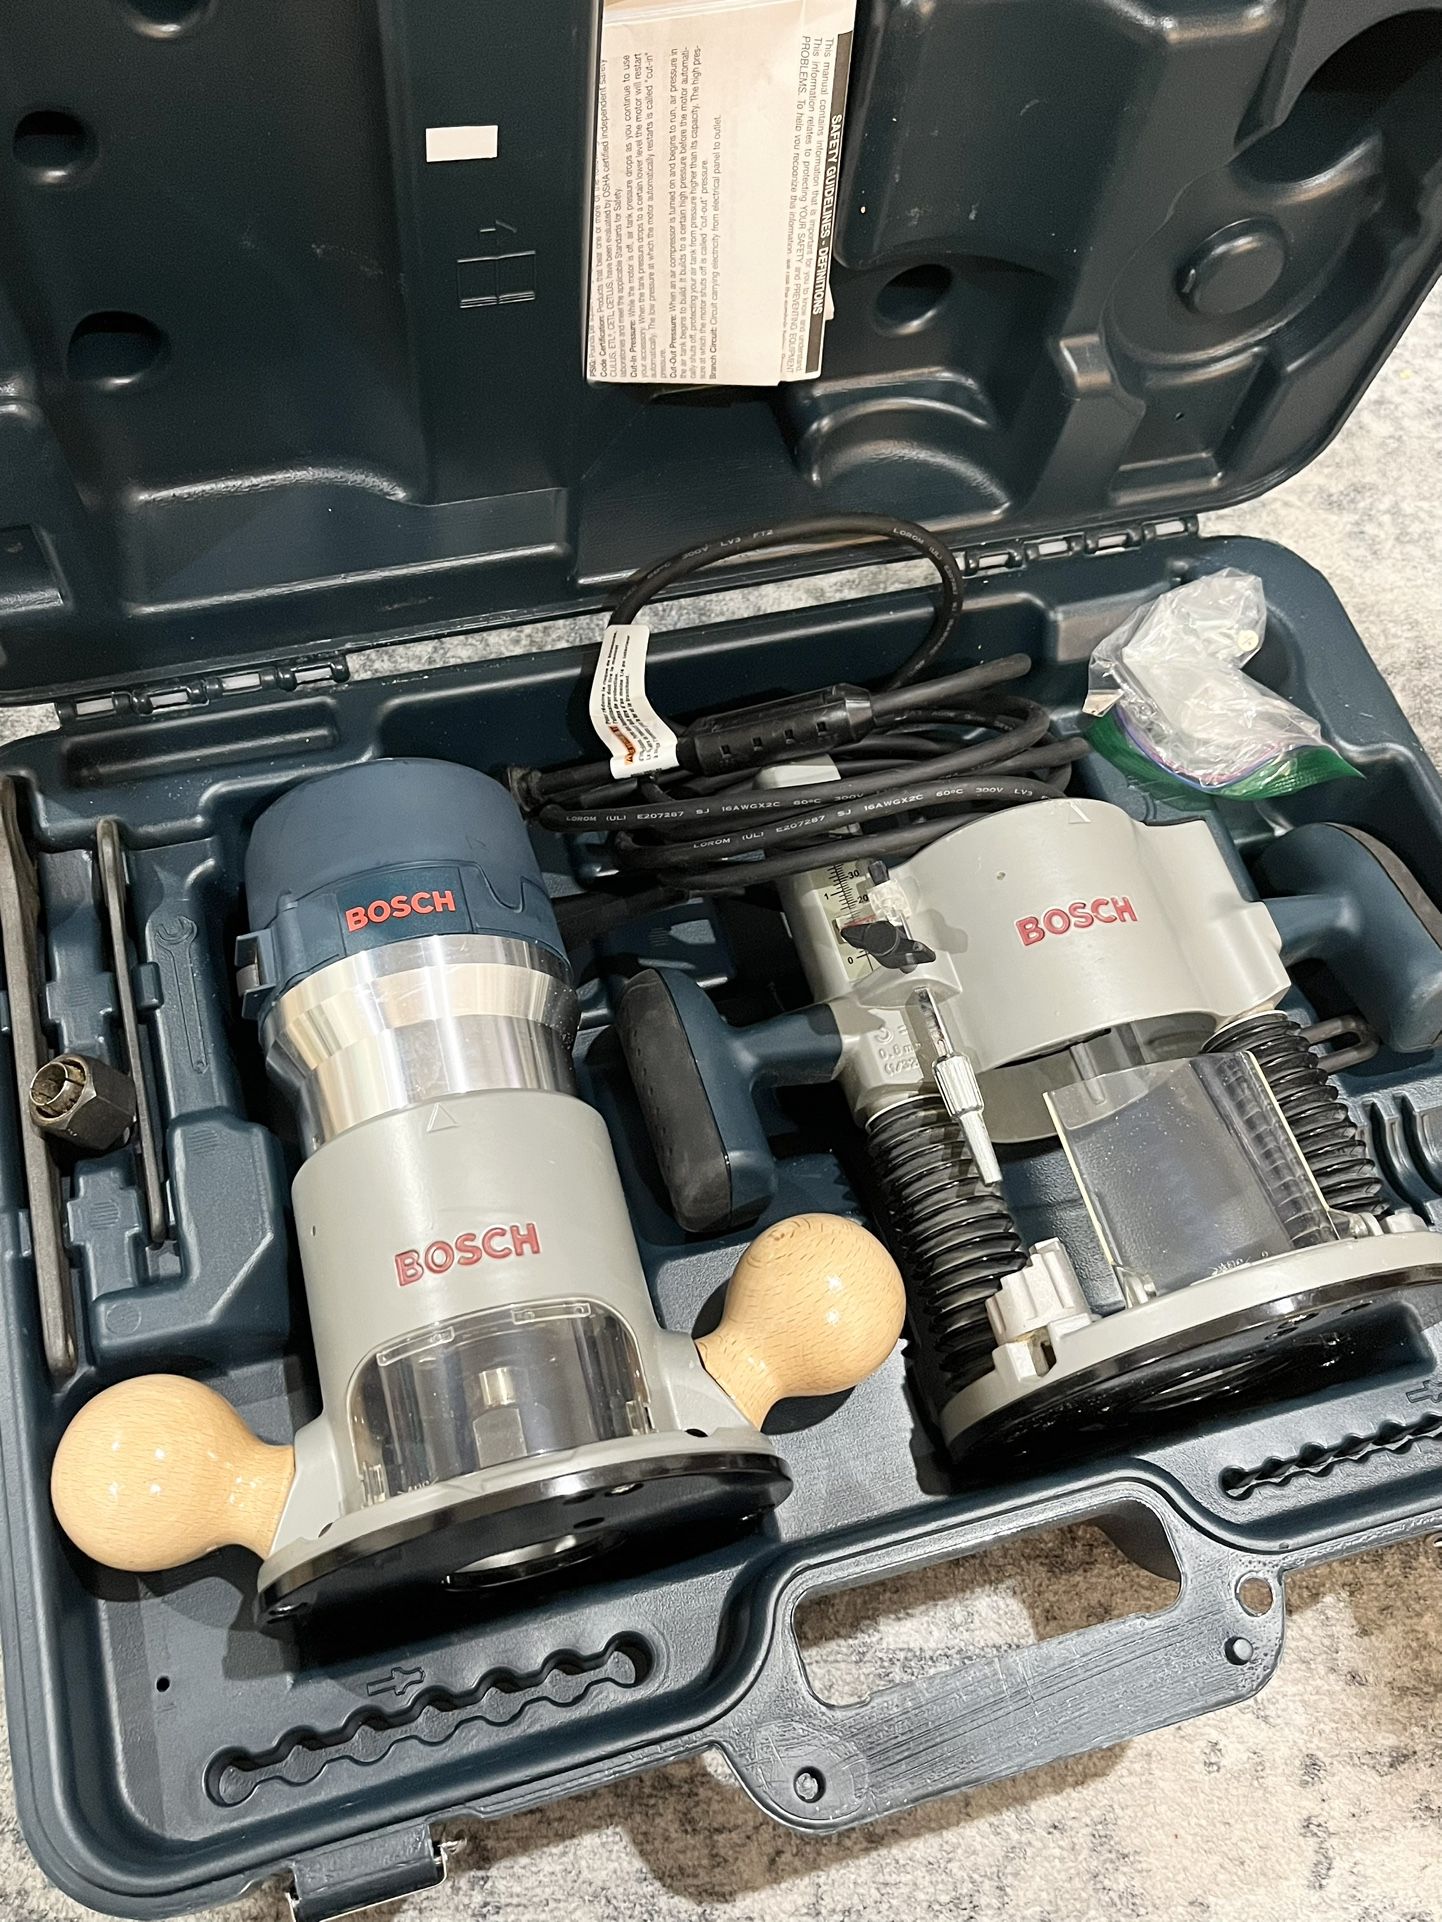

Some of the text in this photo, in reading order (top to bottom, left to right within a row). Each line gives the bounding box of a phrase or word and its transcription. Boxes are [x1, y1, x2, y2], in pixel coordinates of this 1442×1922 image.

[694, 45, 702, 65] pres-
[813, 38, 822, 56] This
[824, 38, 834, 57] This
[671, 58, 679, 92] pressure
[692, 67, 701, 85] high
[798, 36, 810, 96] PROBLEMS.
[821, 62, 830, 94] manual
[691, 86, 699, 102] The
[809, 62, 820, 111] information
[599, 87, 610, 139] independent
[623, 85, 631, 121] continue
[797, 100, 806, 109] To
[634, 124, 642, 137] the
[806, 117, 814, 144] relates
[817, 100, 827, 136] contains
[668, 135, 677, 161] begins
[828, 115, 842, 162] SAFETY
[601, 141, 609, 172] certified
[625, 155, 634, 177] drops
[712, 152, 721, 174] panel
[805, 149, 812, 157] to
[814, 141, 823, 186] information
[602, 174, 610, 198] OSHA
[646, 154, 655, 202] automatically
[680, 156, 688, 189] pressure
[689, 171, 698, 194] higher
[800, 161, 810, 201] protecting
[626, 180, 634, 210] pressure
[679, 191, 688, 207] high
[790, 196, 798, 209] this
[811, 191, 819, 205] that
[821, 167, 836, 238] GUIDELINES
[690, 196, 698, 228] pressure
[799, 206, 808, 229] YOUR
[636, 224, 645, 243] drops
[787, 212, 796, 254] information
[807, 219, 816, 254] important
[637, 245, 645, 274] pressure
[796, 233, 805, 263] SAFETY
[626, 264, 634, 284] motor
[648, 272, 657, 301] pressure
[690, 278, 698, 294] your
[812, 247, 828, 314] DEFINITIONS
[790, 284, 801, 330] PREVENTING
[787, 334, 797, 373] EQUIPMENT
[599, 359, 607, 377] Code
[720, 536, 742, 547] LV3
[753, 529, 774, 539] FT2
[893, 527, 925, 545] LOROM
[606, 814, 627, 822] (UL)
[637, 811, 684, 820] E207287
[696, 807, 710, 815] SJ
[721, 801, 781, 812] 16AWGX2C
[693, 837, 731, 849] LOROM
[742, 831, 764, 841] (UL)
[776, 815, 825, 832] E207287
[837, 808, 851, 817] SJ
[864, 794, 924, 811] 16AWGX2C
[1014, 788, 1033, 797] LV3
[848, 869, 860, 879] 30
[345, 889, 456, 933] BOSCH
[857, 894, 869, 903] 20
[1015, 897, 1138, 946] BOSCH
[848, 956, 854, 965] 0
[394, 1222, 541, 1287] BOSCH
